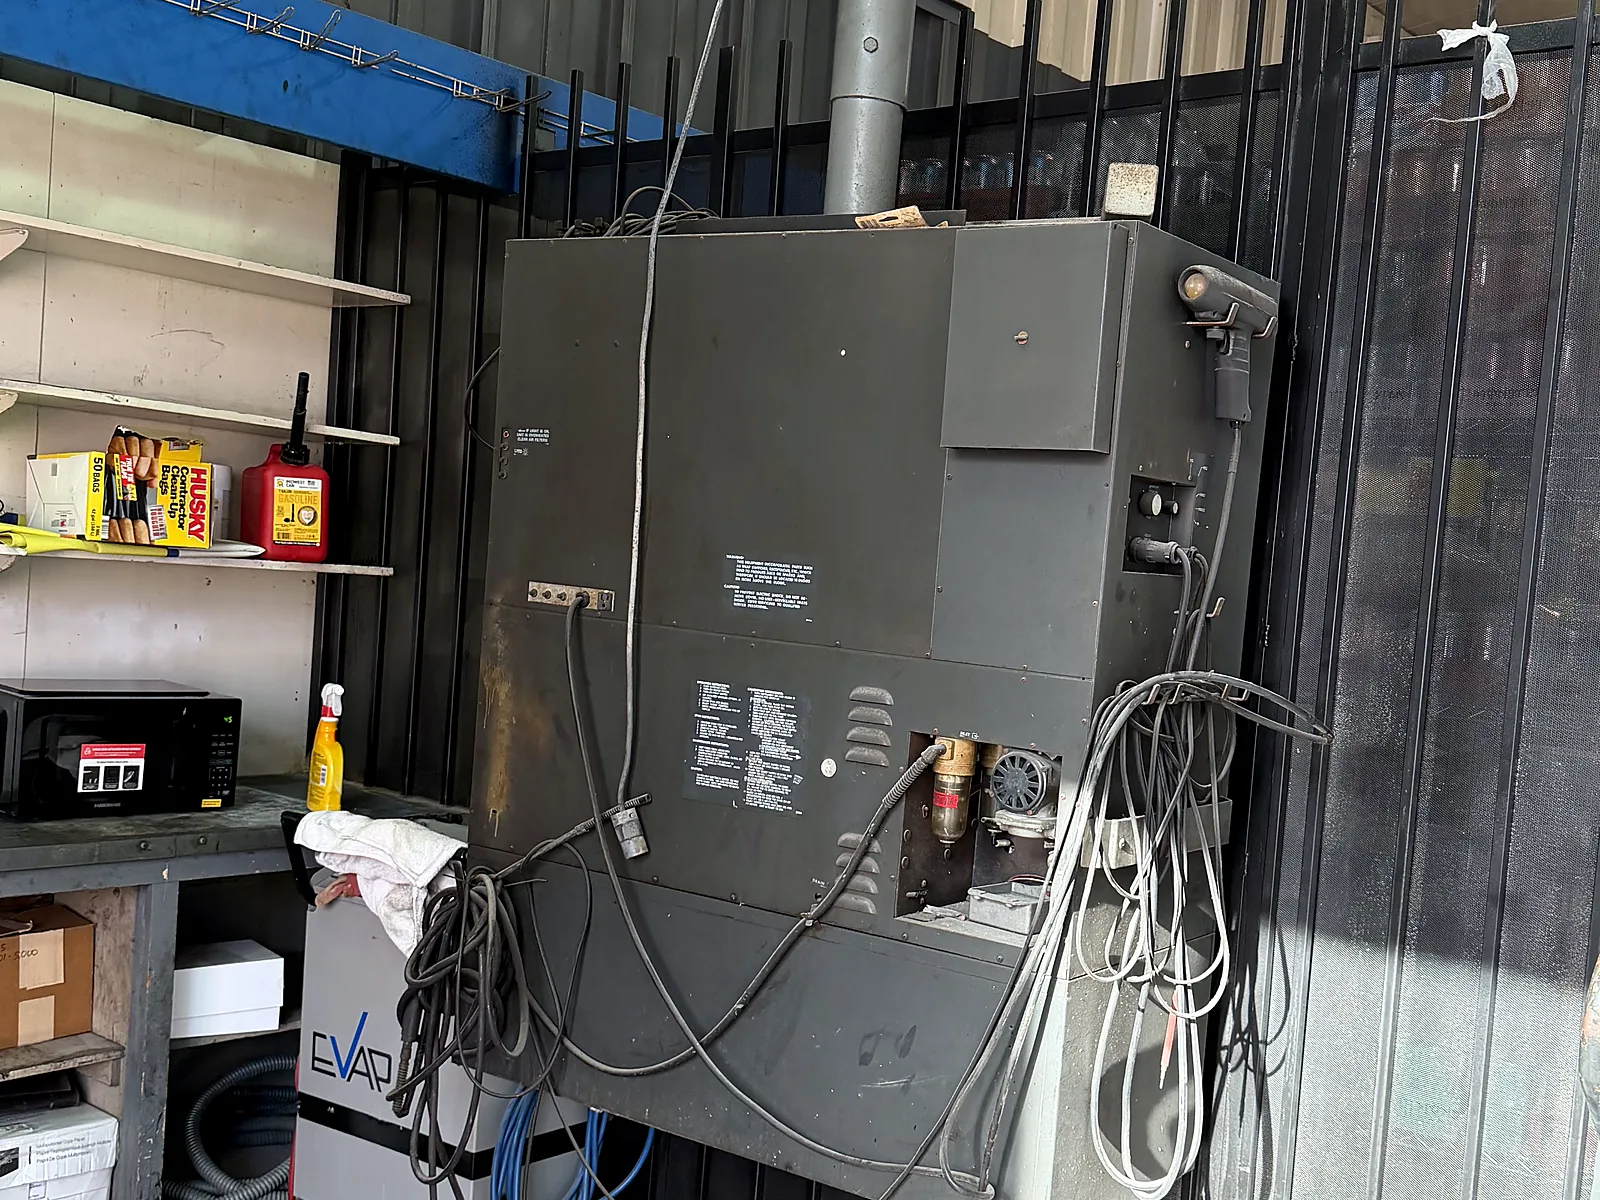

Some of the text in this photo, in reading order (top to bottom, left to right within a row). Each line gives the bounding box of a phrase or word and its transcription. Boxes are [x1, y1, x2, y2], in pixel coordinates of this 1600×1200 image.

[92, 457, 103, 492] 50 BAGS
[159, 464, 170, 496] Bags
[168, 466, 180, 518] Clean-Up
[178, 466, 189, 530] Contractor
[278, 494, 318, 504] GASOLINE
[188, 468, 207, 542] HUSKY
[312, 1011, 392, 1092] EVAP
